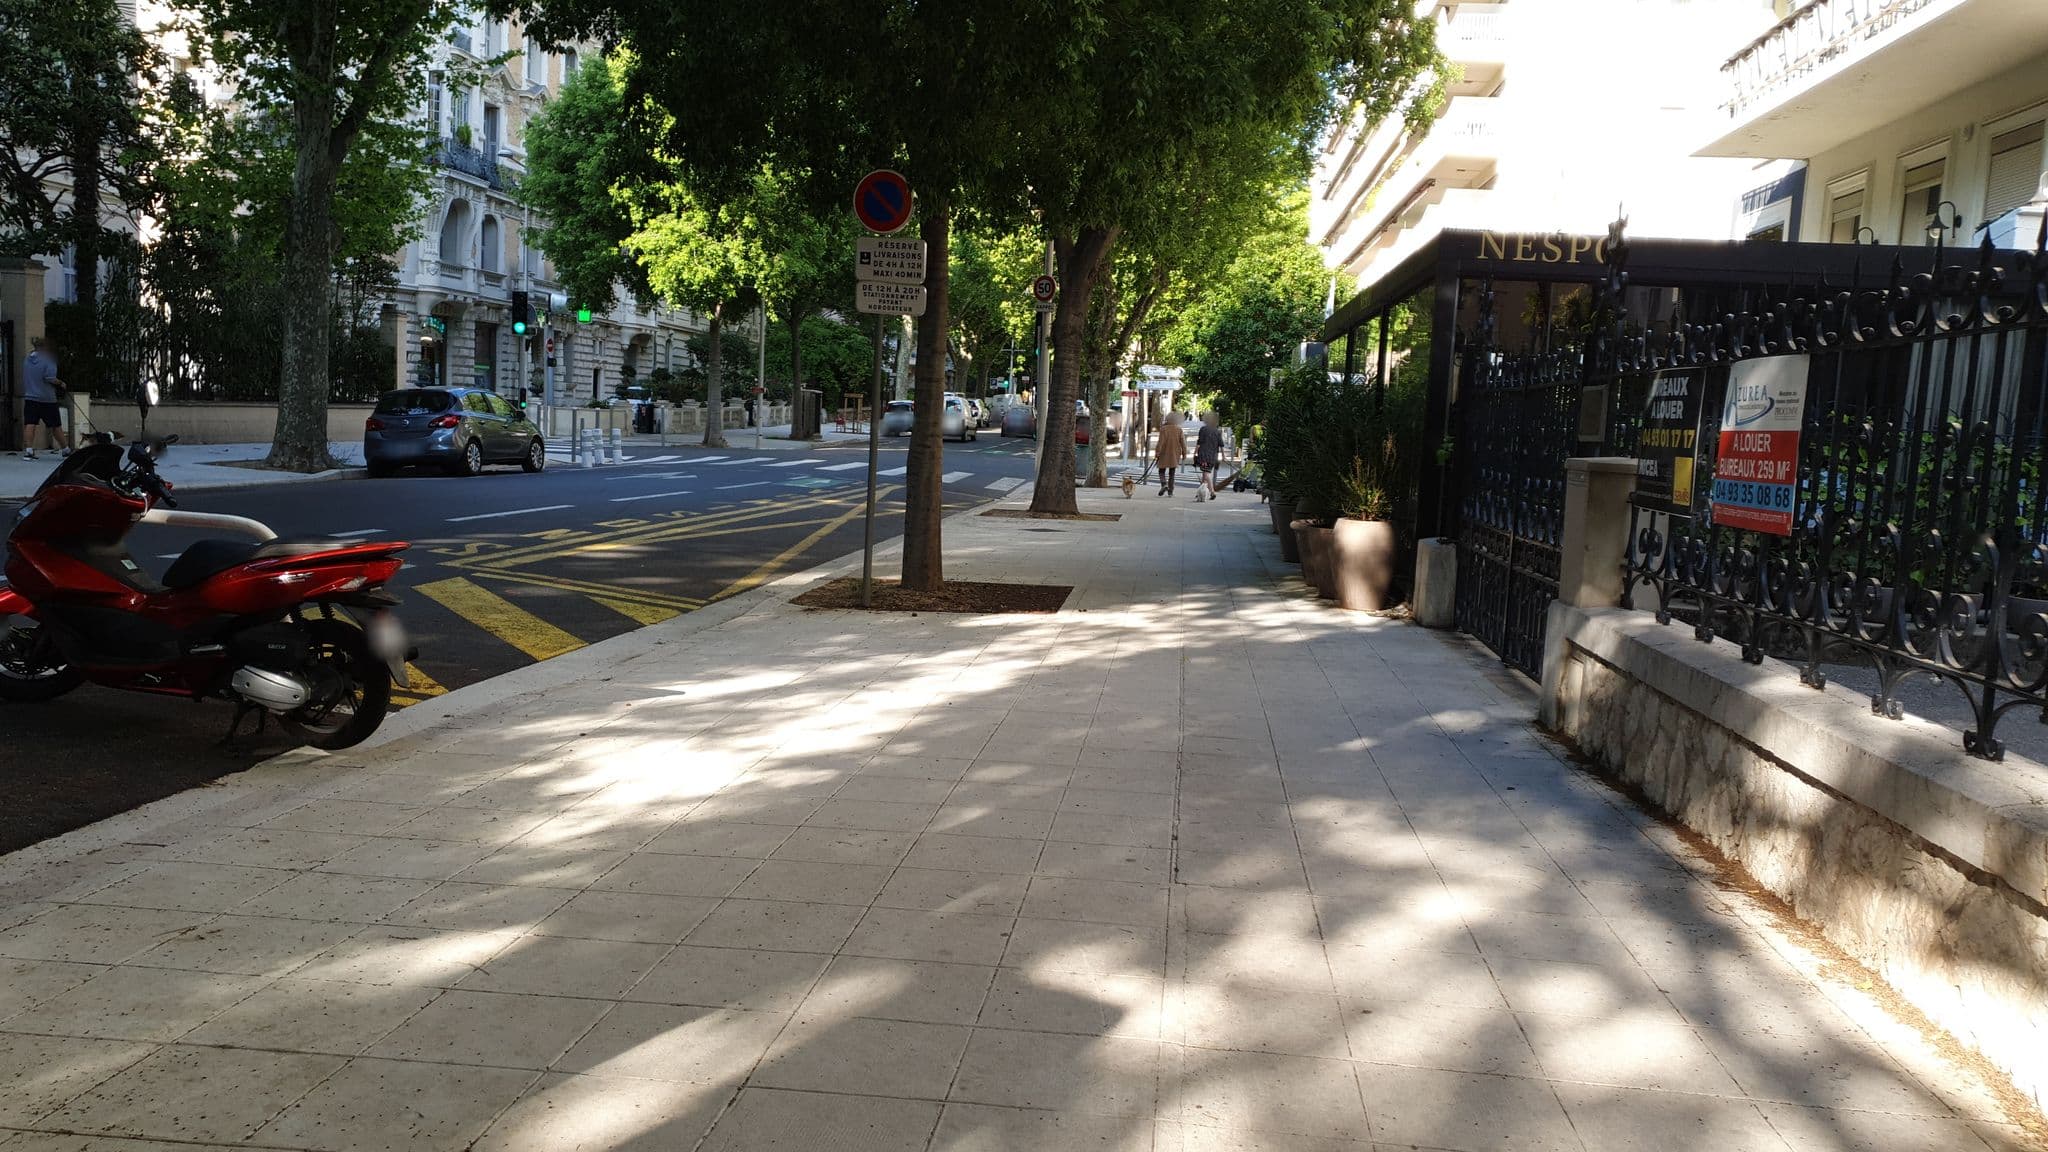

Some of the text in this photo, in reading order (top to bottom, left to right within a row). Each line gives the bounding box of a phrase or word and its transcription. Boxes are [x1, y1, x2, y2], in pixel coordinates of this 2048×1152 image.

[873, 251, 922, 260] LIVRAISONS
[863, 292, 918, 300] STATIONNEMENT
[1038, 282, 1050, 294] 50
[1671, 430, 1681, 447] 17
[1684, 430, 1696, 448] 17
[1740, 433, 1771, 453] LOUER
[1719, 457, 1755, 478] BUREAUX
[1757, 459, 1774, 480] 259
[1716, 483, 1790, 508] 04 93 35 08 68
